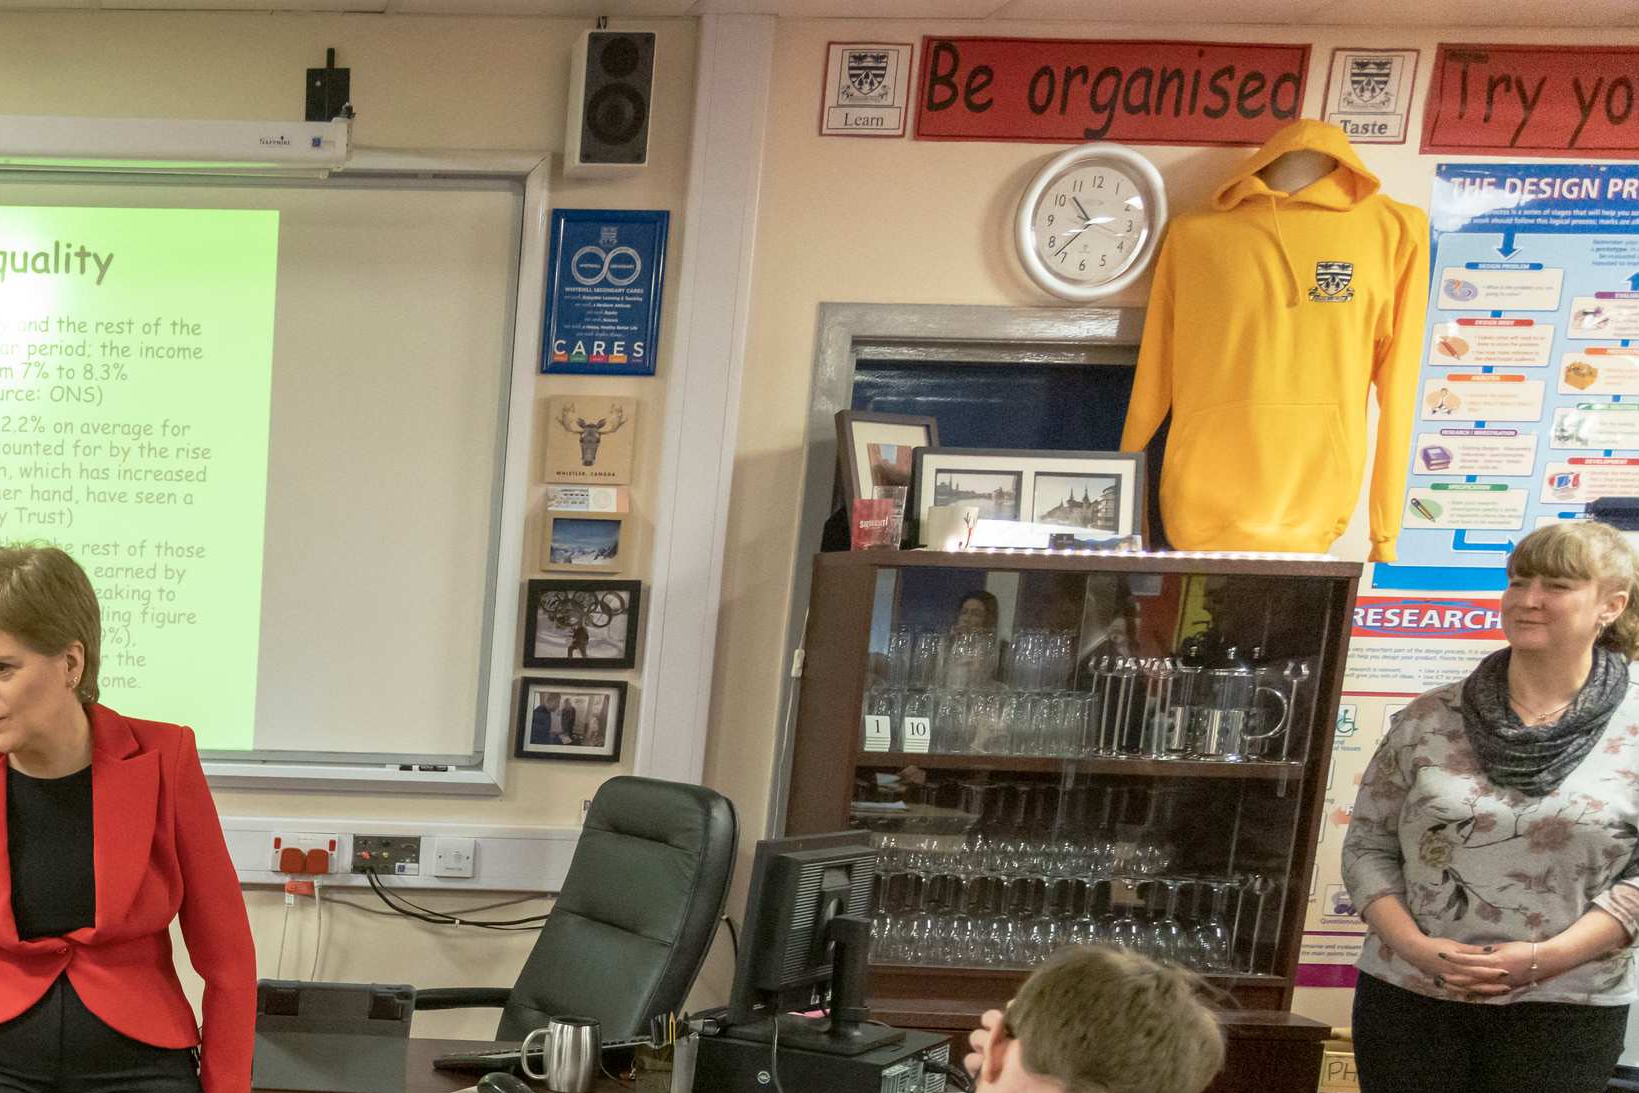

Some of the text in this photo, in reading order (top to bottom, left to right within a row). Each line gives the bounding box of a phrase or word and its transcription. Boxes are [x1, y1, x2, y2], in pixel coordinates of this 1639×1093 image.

[926, 41, 994, 113] Be
[1447, 51, 1634, 148] Try yo
[844, 112, 884, 128] Learn
[1340, 119, 1388, 136] Taste
[1072, 181, 1083, 192] 11
[1092, 176, 1105, 189] 12
[1115, 183, 1120, 195] 1
[1451, 177, 1496, 196] THE
[1504, 177, 1599, 200] DESIGN
[1054, 194, 1067, 207] 10
[1047, 214, 1055, 227] 9
[1126, 220, 1134, 233] 3
[1048, 236, 1056, 248] 8
[1116, 241, 1124, 253] 4
[1060, 252, 1068, 264] 7
[1078, 259, 1086, 271] 6
[1099, 255, 1107, 267] 5
[17, 316, 49, 333] and
[57, 317, 87, 334] the
[95, 319, 134, 335] rest
[141, 318, 163, 336] of
[170, 319, 202, 336] the
[100, 341, 131, 358] the
[139, 342, 204, 360] income
[554, 340, 644, 358] CARES
[22, 362, 49, 380] 7%
[57, 364, 75, 380] to
[83, 363, 128, 381] 8.3%
[49, 385, 104, 407] ONS)
[1, 416, 45, 433] 2.2%
[53, 420, 73, 434] on
[80, 421, 153, 440] average
[161, 419, 191, 437] for
[72, 439, 102, 458] for
[109, 441, 131, 462] by
[137, 442, 169, 459] the
[175, 443, 212, 460] rise
[19, 461, 71, 480] which
[79, 463, 110, 480] has
[117, 464, 207, 482] increased
[1353, 608, 1502, 630] RESEARCH
[875, 719, 881, 733] 1
[910, 721, 926, 736] 10
